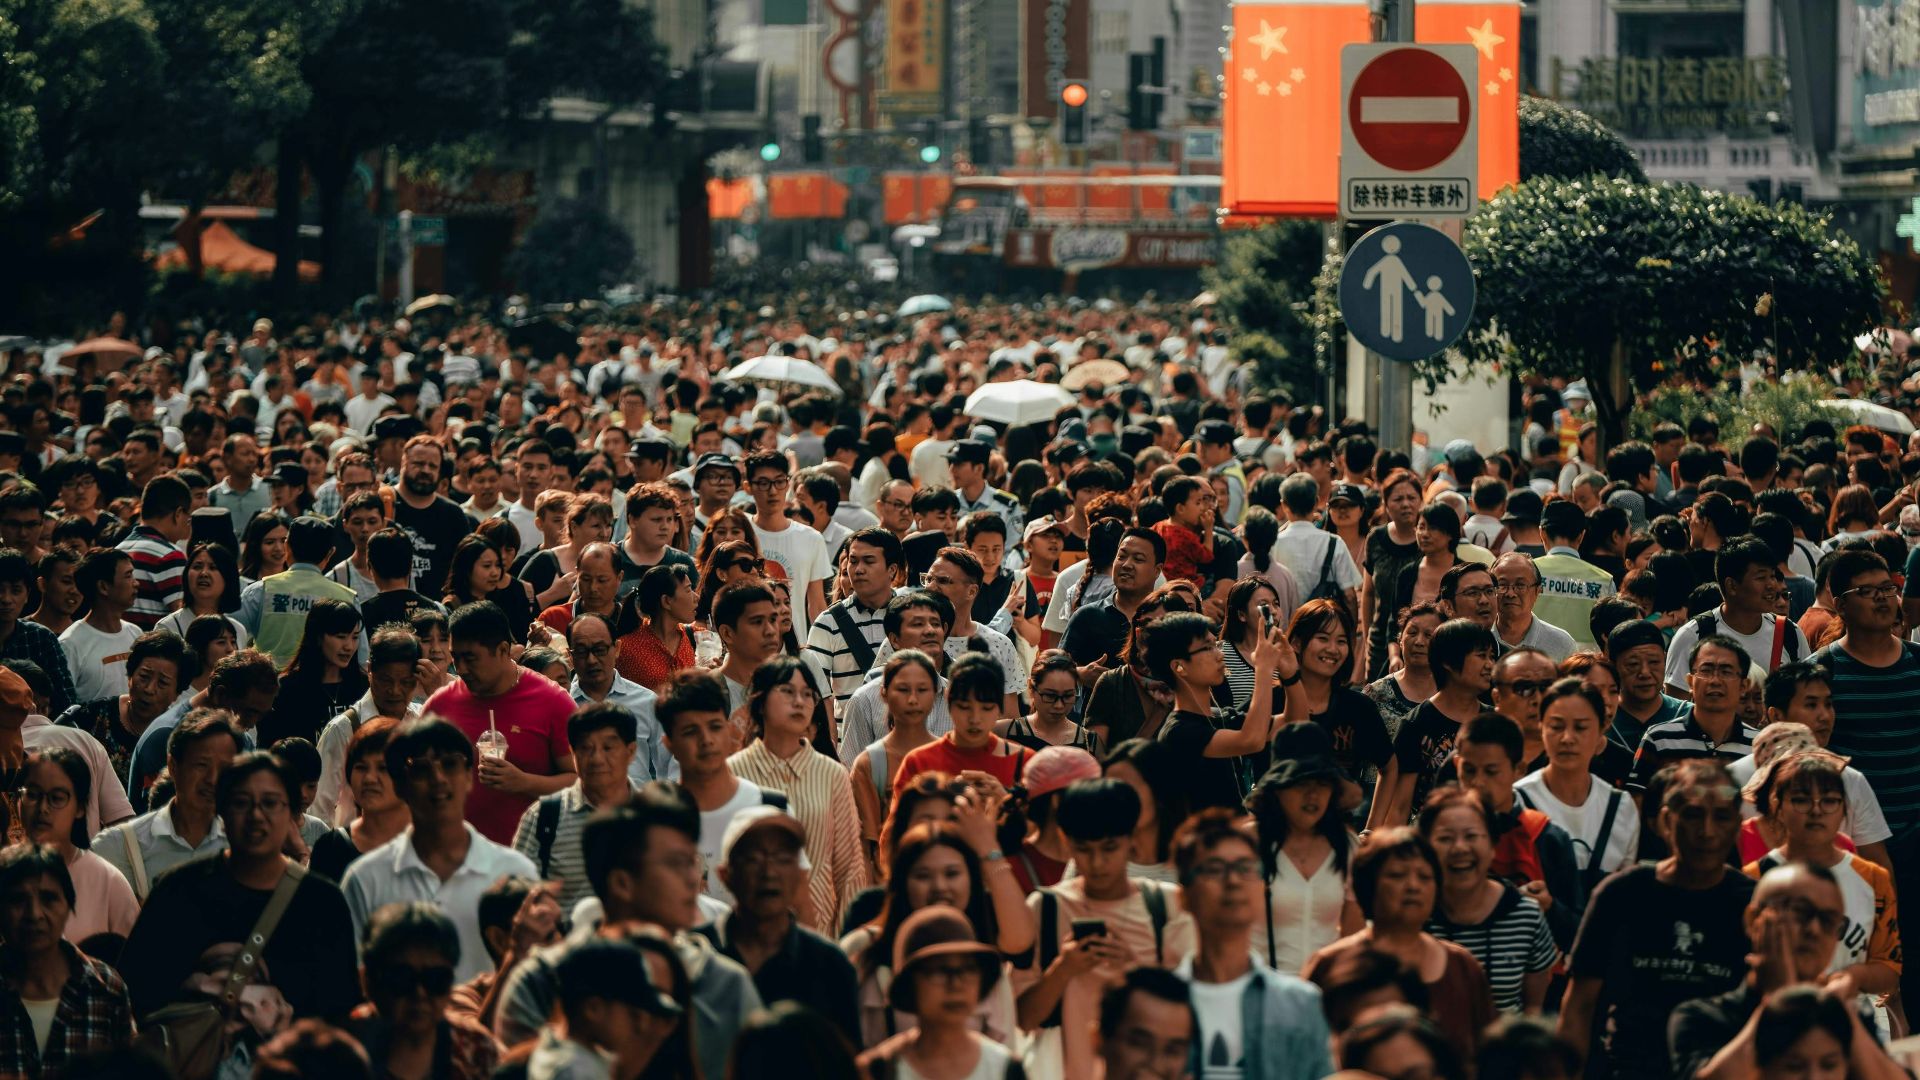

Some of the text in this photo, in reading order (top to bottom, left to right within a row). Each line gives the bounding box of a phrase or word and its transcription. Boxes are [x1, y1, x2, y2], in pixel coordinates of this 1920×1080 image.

[1353, 184, 1464, 208] 除特种车辆外
[1549, 579, 1584, 595] POLICE
[1586, 581, 1602, 599] 察
[272, 593, 314, 613] 警 POL
[1332, 725, 1355, 751] NY
